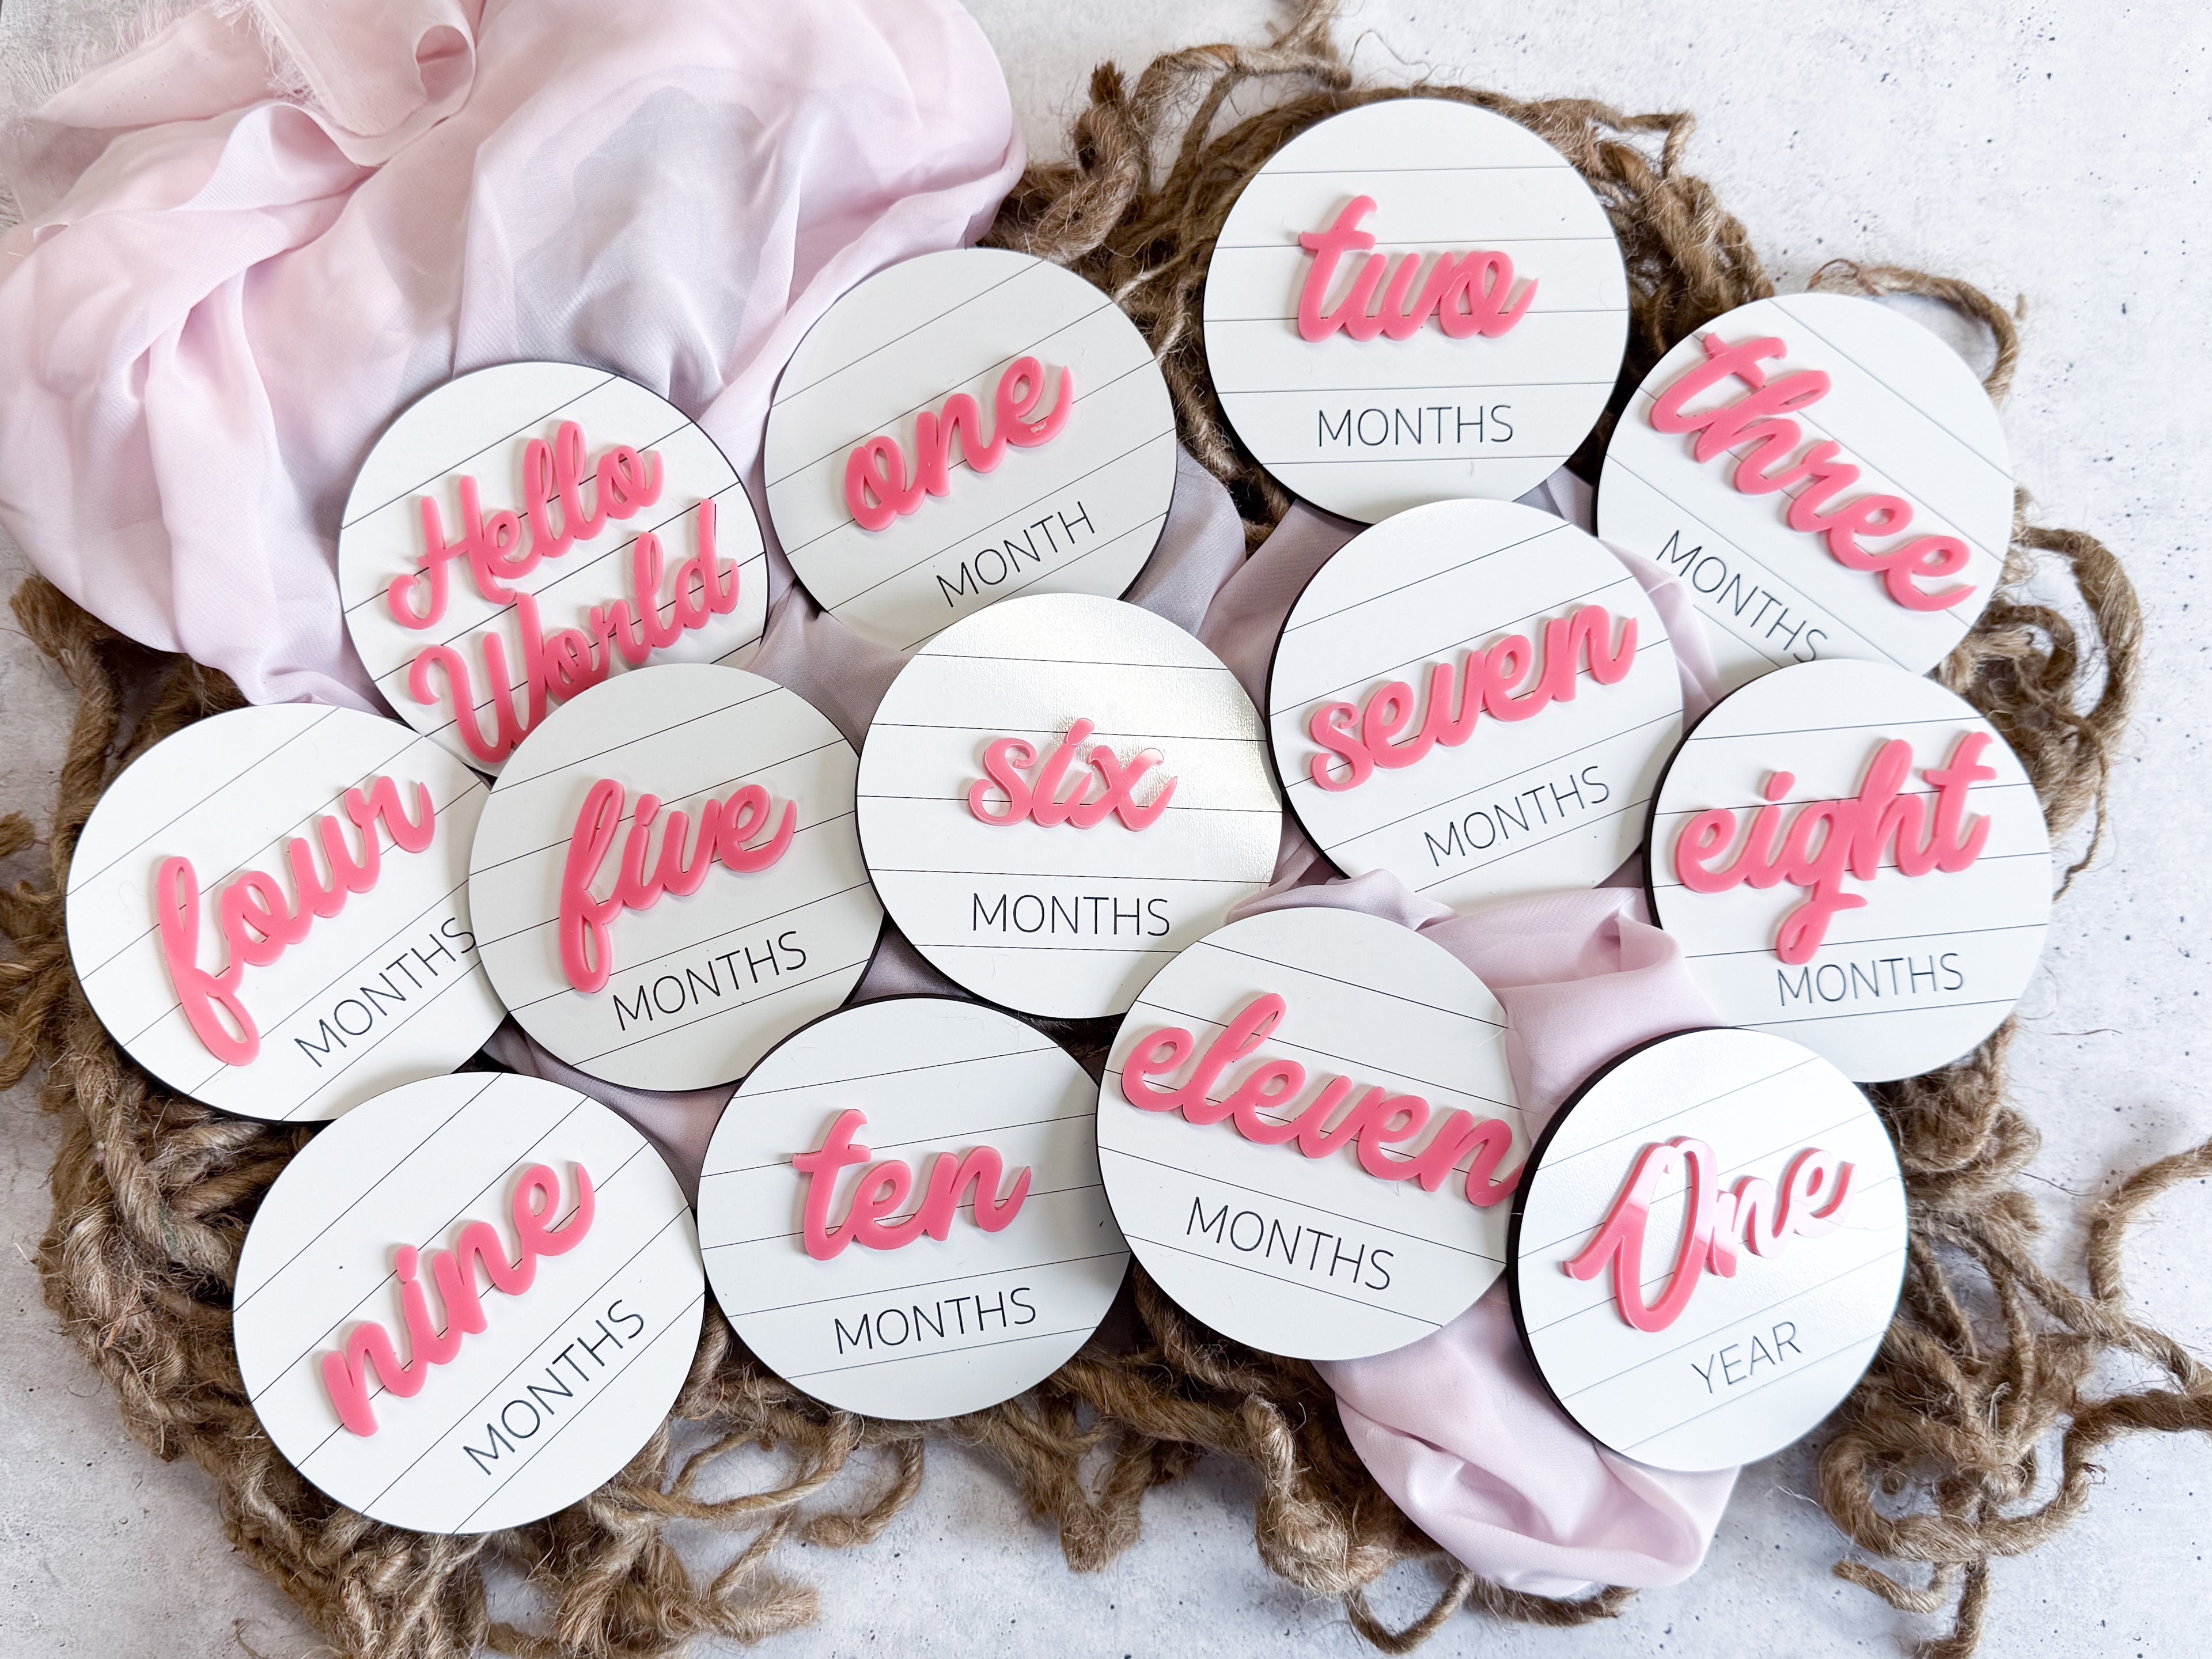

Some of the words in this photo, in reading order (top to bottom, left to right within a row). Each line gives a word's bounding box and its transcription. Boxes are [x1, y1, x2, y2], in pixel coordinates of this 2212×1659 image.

[1297, 195, 1539, 343] two
[844, 356, 1073, 532] one
[1319, 404, 1513, 448] MONTHS
[1649, 332, 1976, 612] three
[387, 421, 664, 630] Hello
[936, 501, 1094, 608] MONTH
[1656, 529, 1828, 662] MONTHS
[408, 498, 741, 764] World
[1309, 604, 1638, 793] seven
[968, 717, 1178, 832] six
[1424, 766, 1609, 867] MONTHS
[1674, 731, 1998, 965] eight
[157, 775, 436, 1066] four
[559, 778, 797, 994] five
[972, 892, 1170, 937] MONTHS
[294, 916, 477, 1068] MONTHS
[612, 930, 806, 1031] MONTHS
[1777, 952, 1963, 1006] MONTHS
[1121, 993, 1525, 1207] eleven
[792, 1109, 1032, 1262] ten
[1186, 1196, 1394, 1290] MONTHS
[1562, 1135, 1857, 1333] One
[321, 1161, 596, 1438] nine
[834, 1287, 1036, 1354] MONTHS
[1690, 1320, 1802, 1394] YEAR
[463, 1299, 645, 1476] MONTHS
